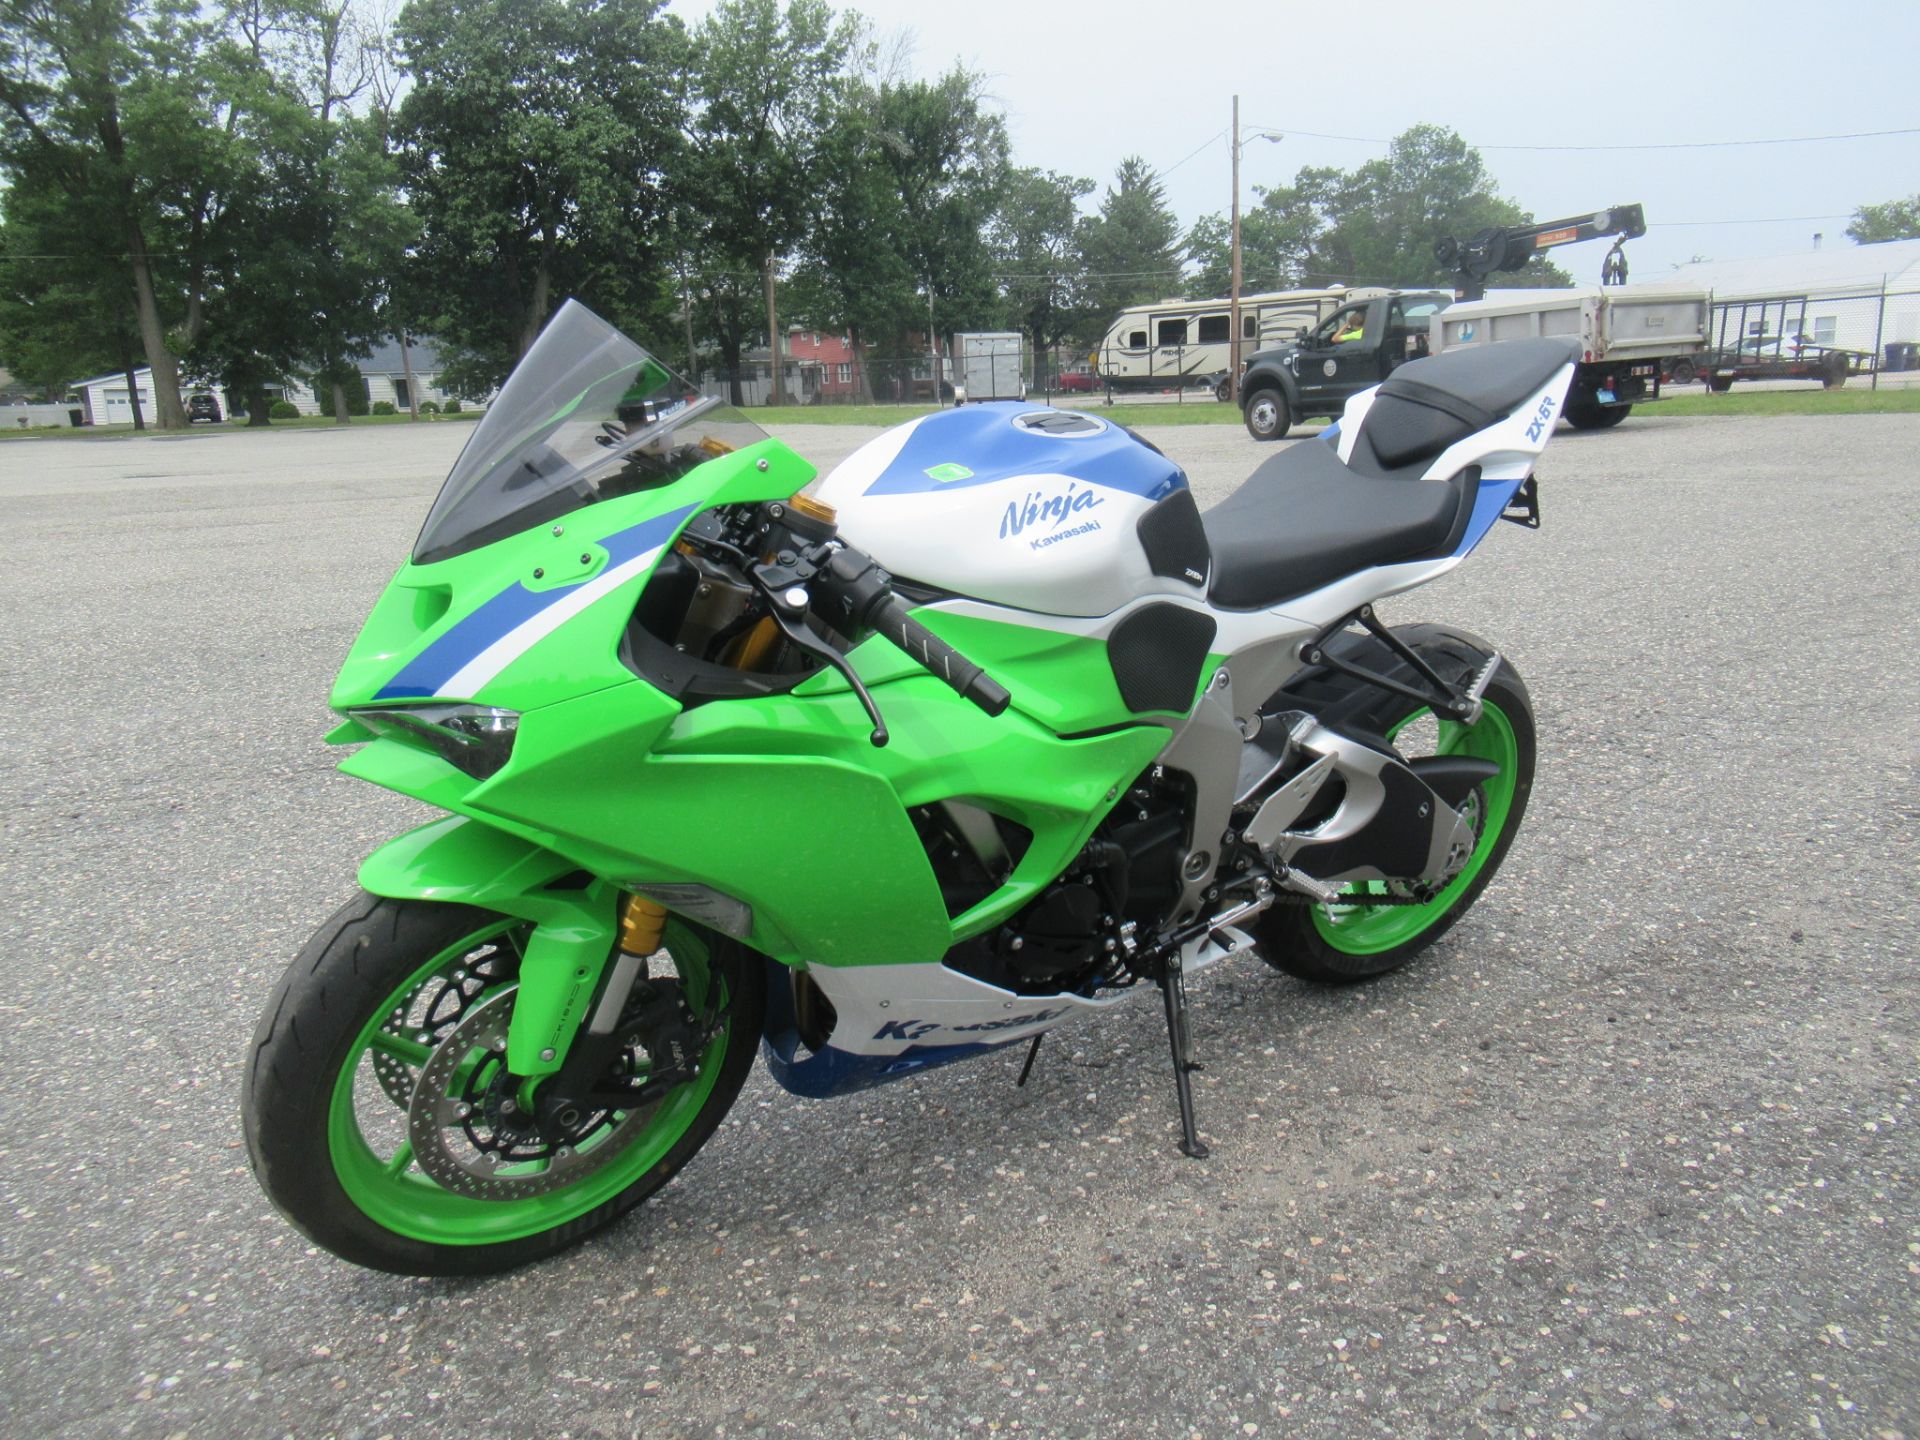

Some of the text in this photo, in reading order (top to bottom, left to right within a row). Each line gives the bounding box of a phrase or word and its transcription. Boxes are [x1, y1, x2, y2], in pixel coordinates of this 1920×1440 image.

[1525, 396, 1556, 443] ZX-6R
[999, 482, 1105, 539] Ninja
[1030, 519, 1102, 551] Kawasaki
